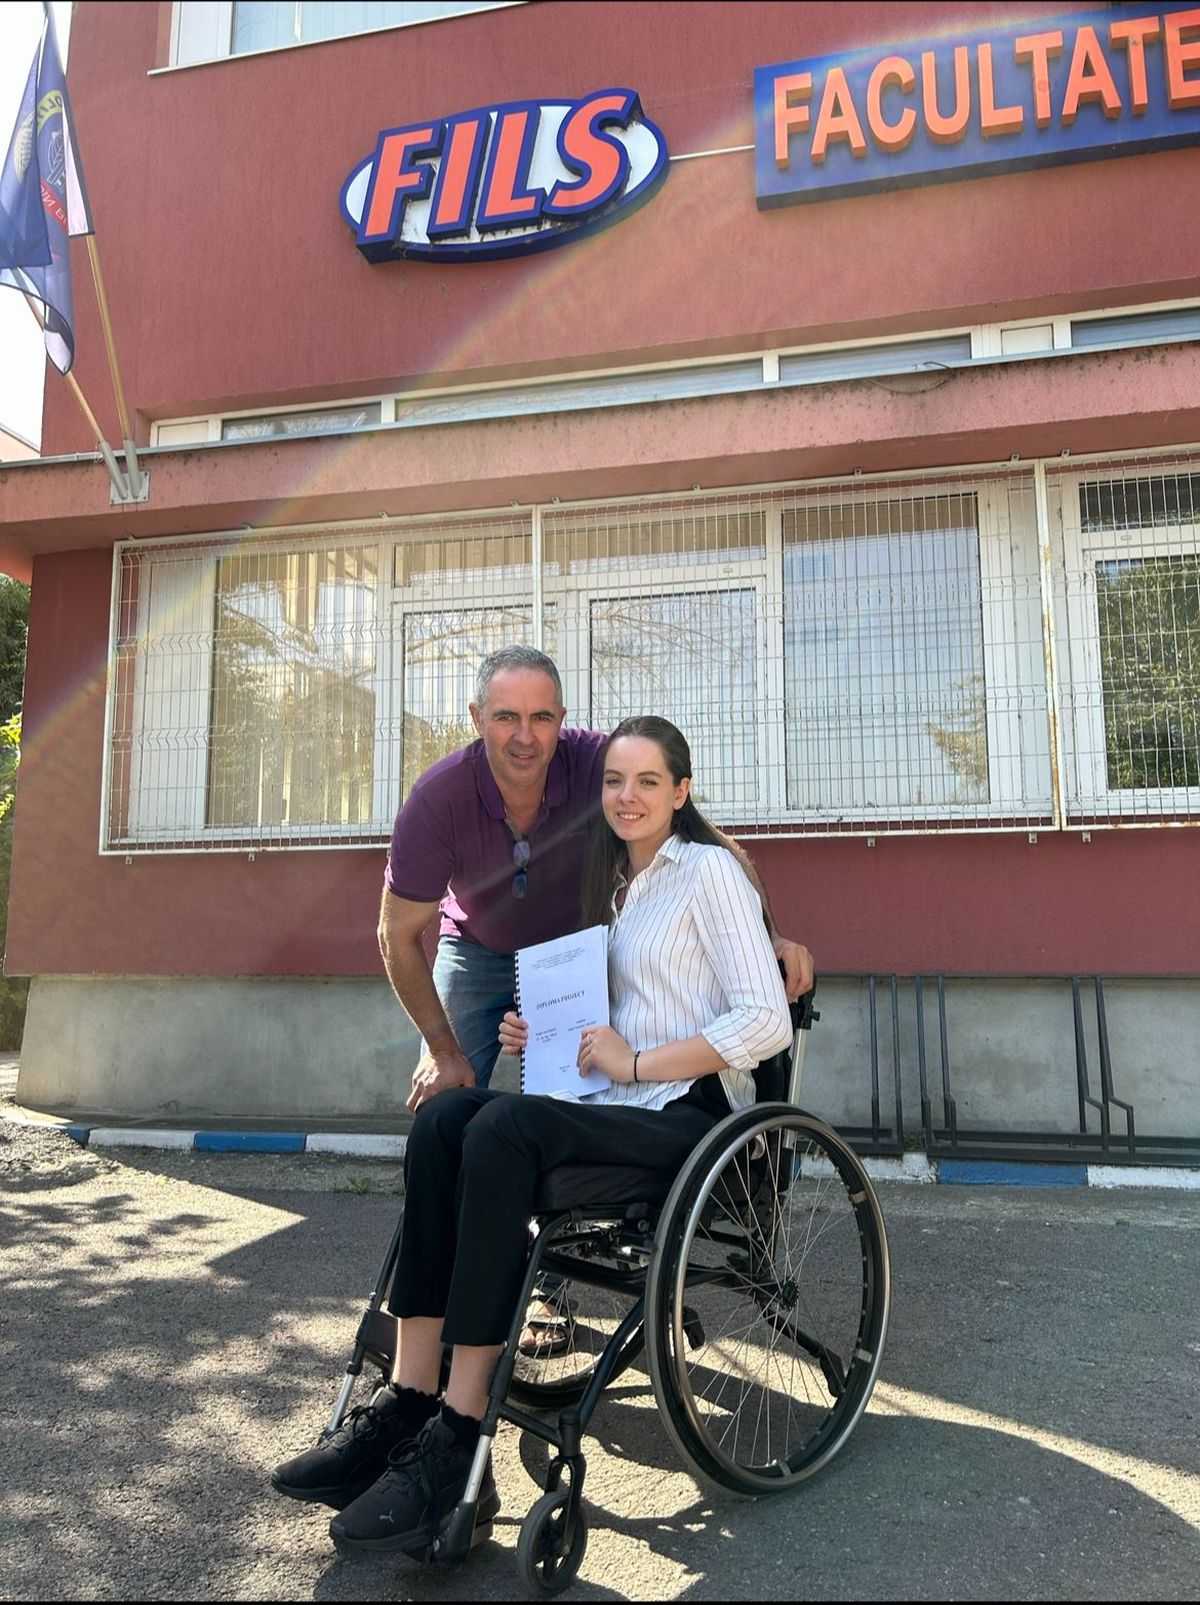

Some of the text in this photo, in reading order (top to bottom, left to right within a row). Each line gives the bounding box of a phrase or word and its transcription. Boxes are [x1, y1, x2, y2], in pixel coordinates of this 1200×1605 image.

[774, 9, 1200, 167] FACULTATE
[360, 91, 636, 243] FILS
[536, 989, 585, 1010] DIPLOMA PROJECT
